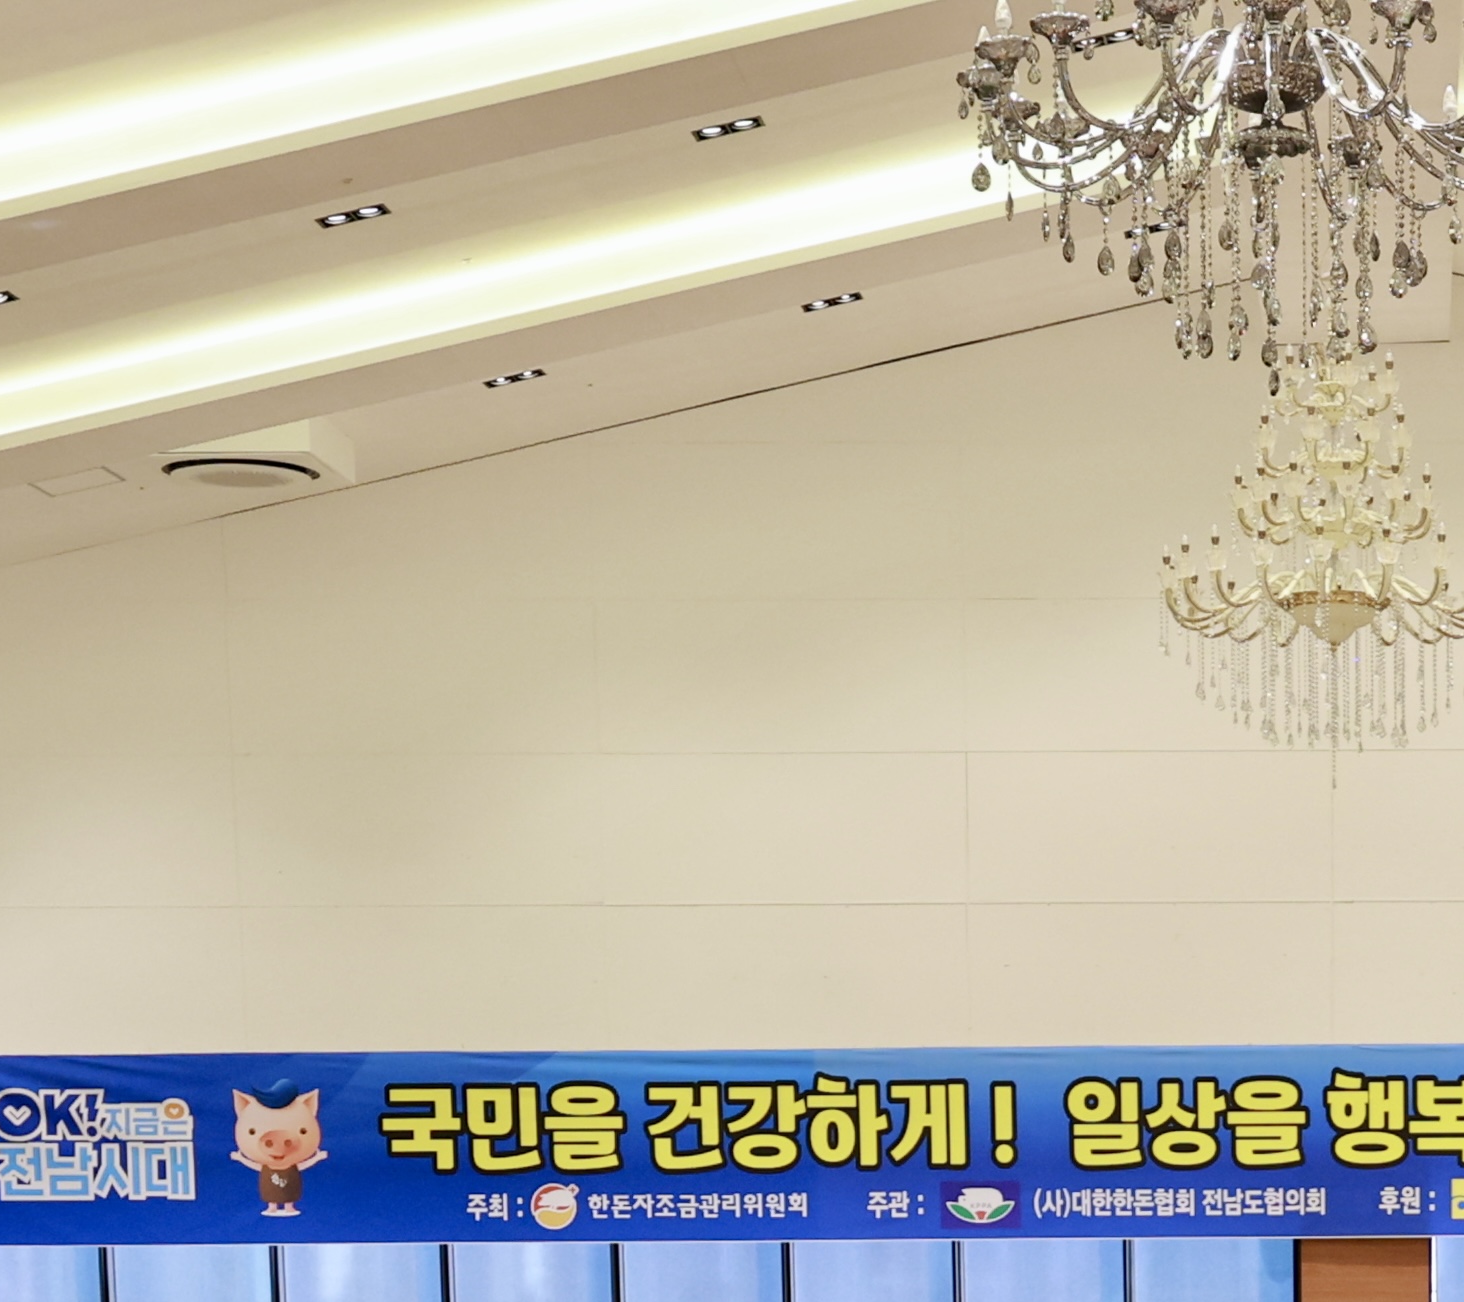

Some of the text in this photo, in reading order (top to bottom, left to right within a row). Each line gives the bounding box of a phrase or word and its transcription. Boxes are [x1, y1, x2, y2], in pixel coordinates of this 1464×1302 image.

[102, 1097, 194, 1141] 지금은
[382, 1086, 623, 1171] 국민을
[648, 1077, 959, 1170] 건강하게
[1067, 1080, 1306, 1166] 일상을
[466, 1192, 509, 1222] 주최
[587, 1192, 808, 1219] 한돈자조금관리위원회
[866, 1190, 911, 1219] 주관
[1033, 1187, 1326, 1219] (사)대한한돈협회 전남도협의회
[1378, 1186, 1421, 1215] 후원
